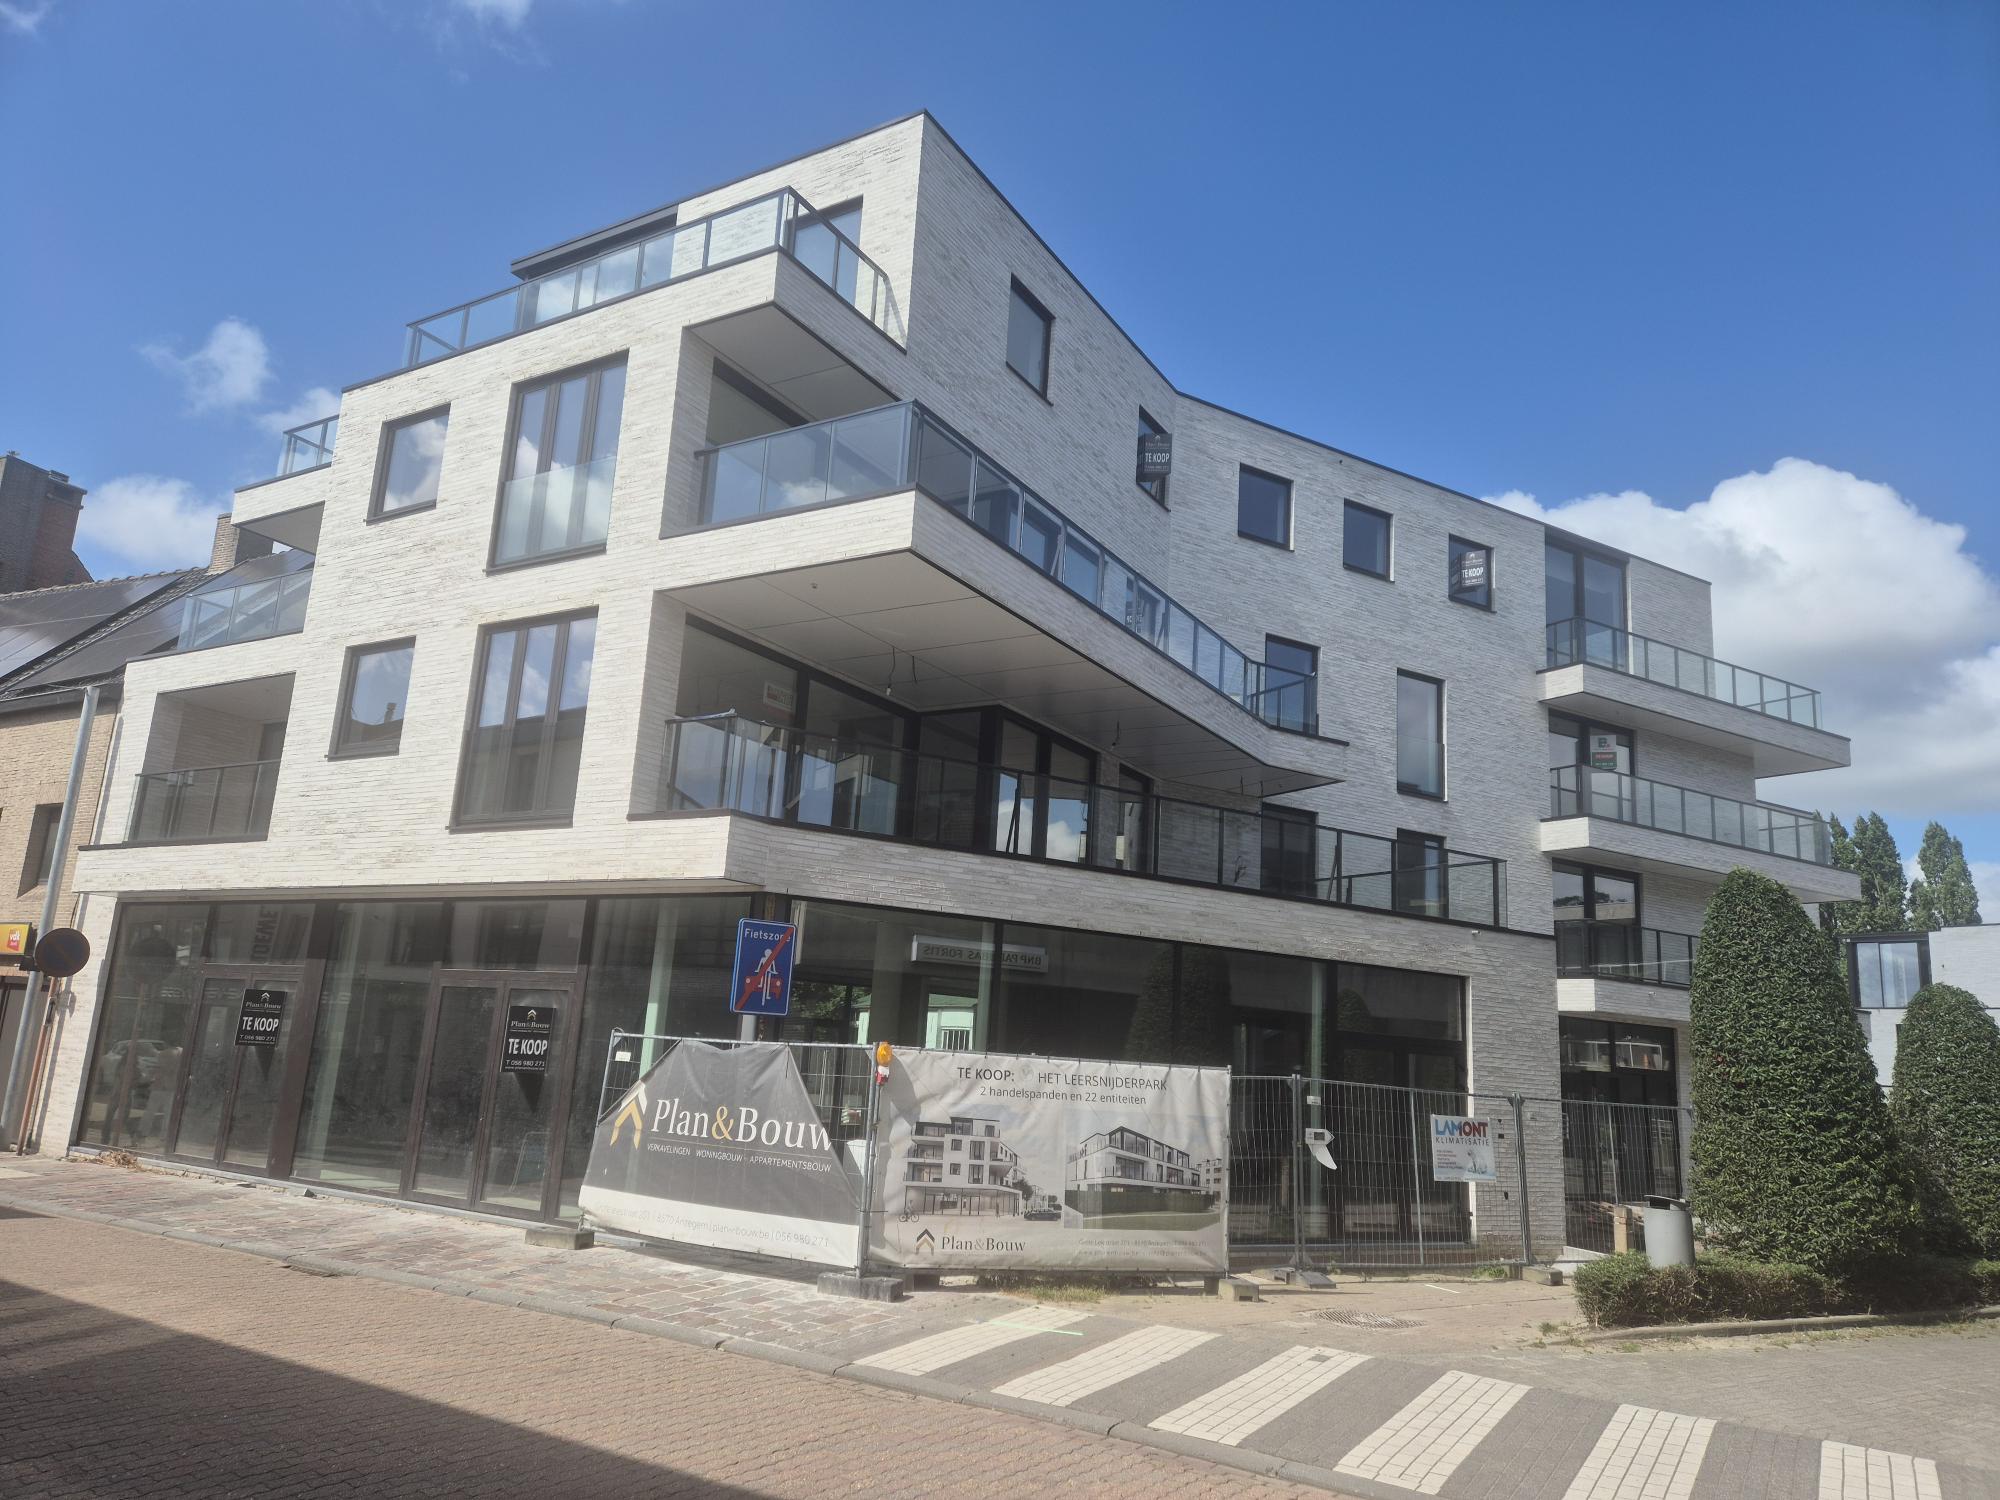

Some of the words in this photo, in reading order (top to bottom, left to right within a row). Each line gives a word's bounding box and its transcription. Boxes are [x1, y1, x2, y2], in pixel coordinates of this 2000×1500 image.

[1145, 452, 1152, 462] TE
[1153, 452, 1170, 463] KOOP
[1469, 566, 1484, 577] KOOP
[242, 1016, 254, 1030] TE
[253, 1017, 279, 1031] KOOP
[508, 1038, 520, 1054] TE
[520, 1039, 548, 1055] KOOP
[957, 1066, 972, 1080] TE
[975, 1068, 1015, 1082] KOOP:
[1038, 1072, 1060, 1085] HET
[1064, 1073, 1168, 1092] LEERSNIJDERPARK
[980, 1086, 986, 1096] 2
[989, 1086, 1068, 1102] handelspanden
[1070, 1092, 1082, 1102] en
[1085, 1091, 1096, 1102] 22
[1100, 1093, 1147, 1105] entiteiten
[1434, 1119, 1488, 1138] LAMONT
[1435, 1136, 1490, 1147] KLIMATISATIE
[647, 1143, 691, 1156] VERKAVELINGEN
[695, 1149, 743, 1163] WONINGBOUW
[749, 1155, 832, 1173] APPARTEMENTSBOUW
[941, 1235, 1026, 1252] Plan&Bouw
